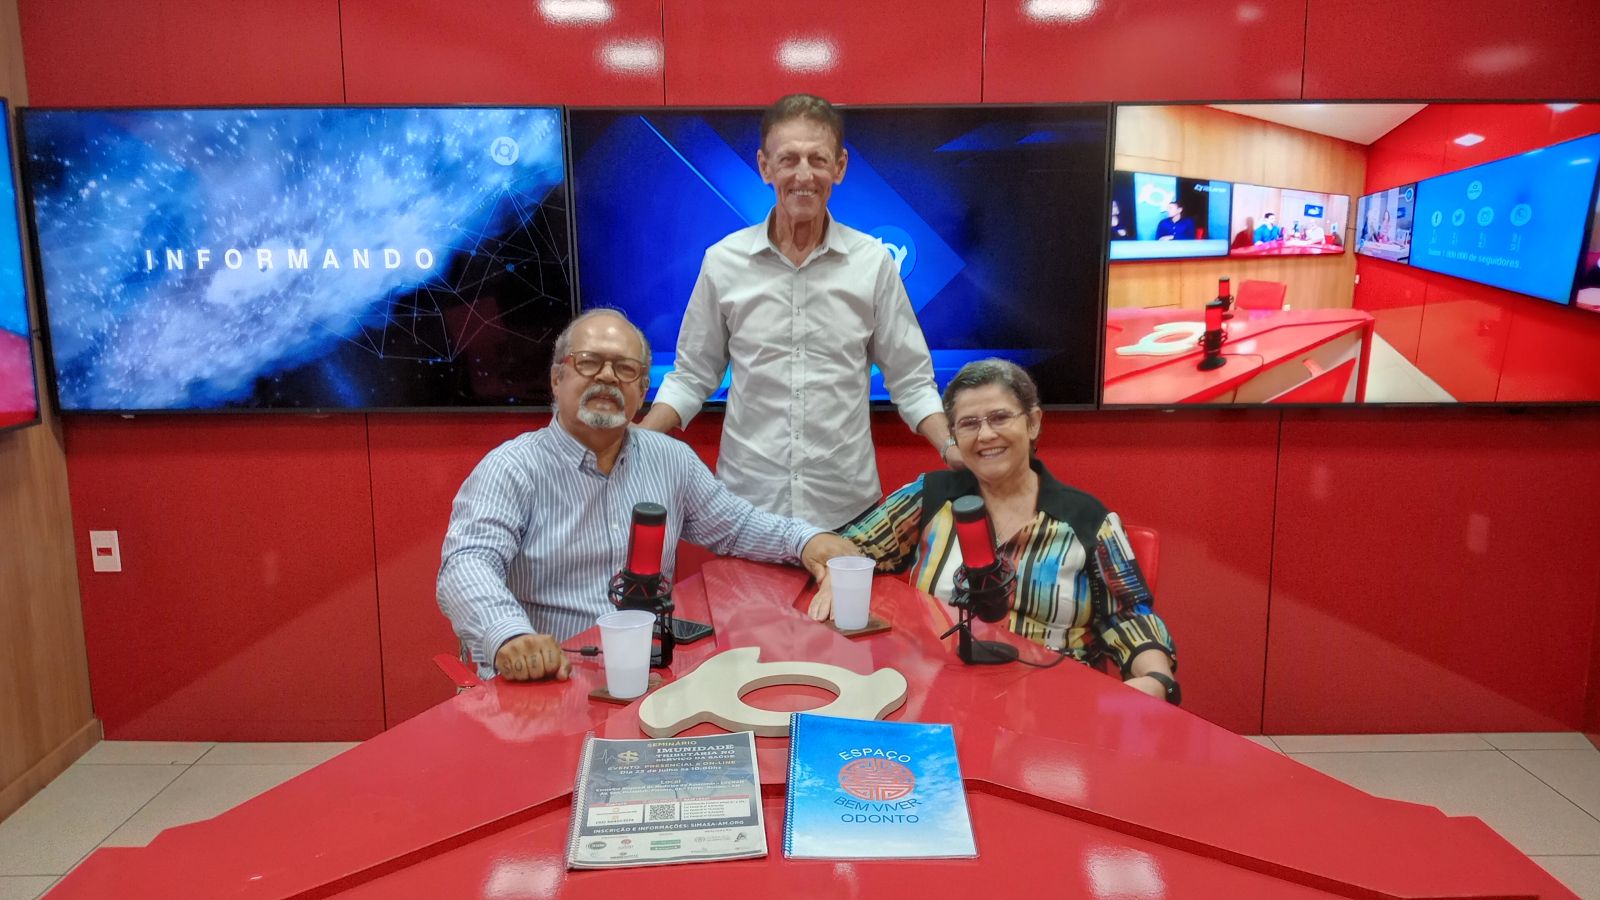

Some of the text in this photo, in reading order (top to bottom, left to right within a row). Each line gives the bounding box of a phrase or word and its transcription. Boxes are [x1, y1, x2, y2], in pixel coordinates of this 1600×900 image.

[146, 248, 434, 270] INFORMANDO
[647, 740, 697, 748] SEMINÁRIO
[656, 744, 735, 753] IMUNIDADE
[838, 747, 912, 763] ESPAÇO
[833, 796, 923, 812] BEM VIVER
[841, 814, 919, 824] ODONTO
[593, 826, 631, 834] INSCRIÇÃO
[638, 822, 689, 831] INFORMAÇÕES:
